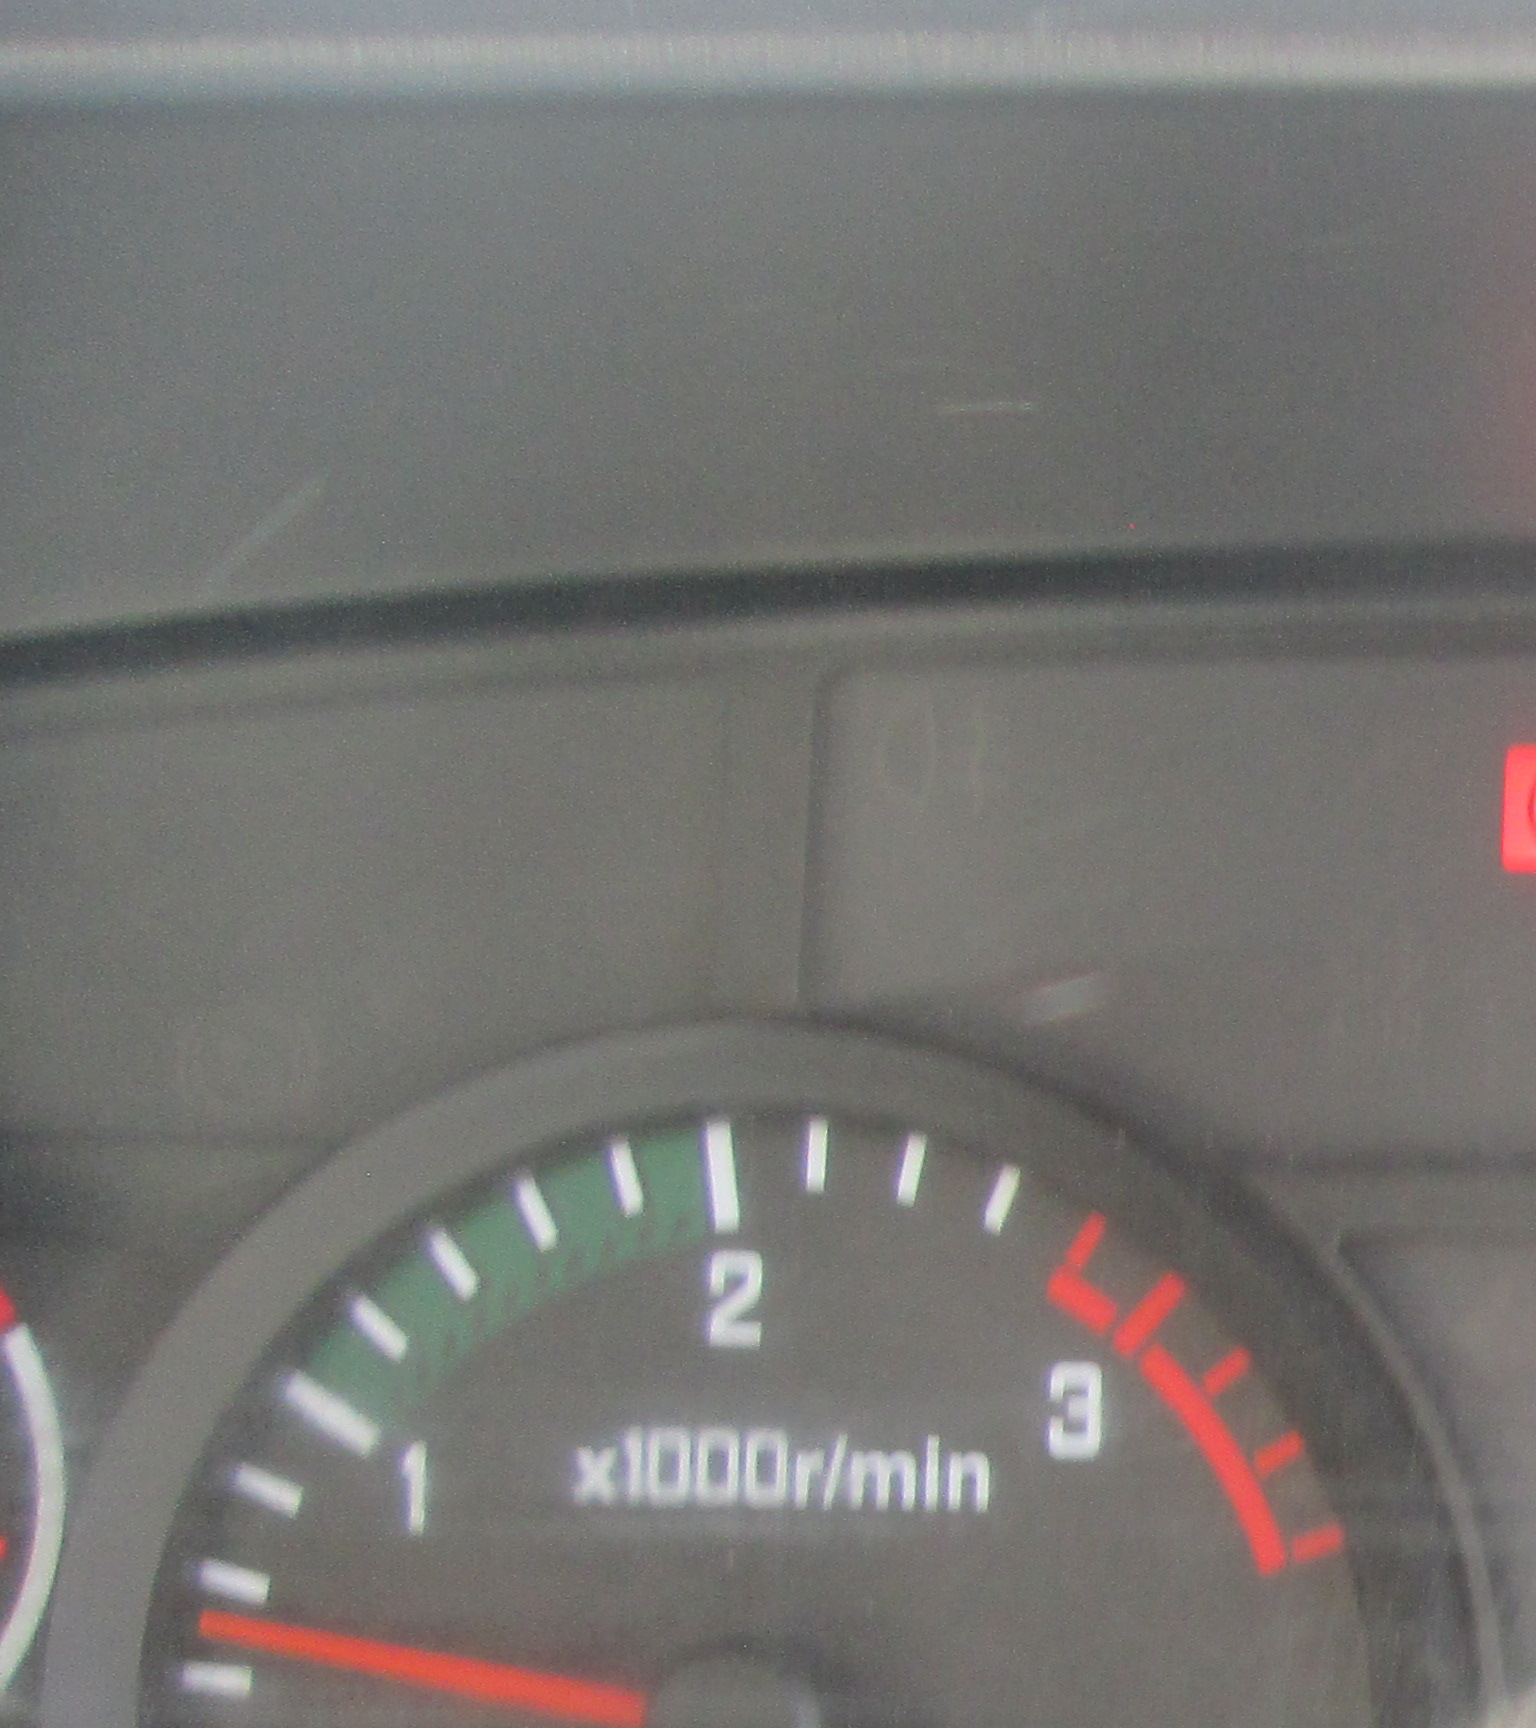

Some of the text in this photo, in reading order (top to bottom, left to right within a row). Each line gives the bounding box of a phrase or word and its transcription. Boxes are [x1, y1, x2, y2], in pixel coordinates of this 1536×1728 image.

[705, 1249, 764, 1349] 2
[1046, 1362, 1104, 1460] 3
[402, 1440, 432, 1535] 1
[570, 1426, 992, 1514] x1000r/min
